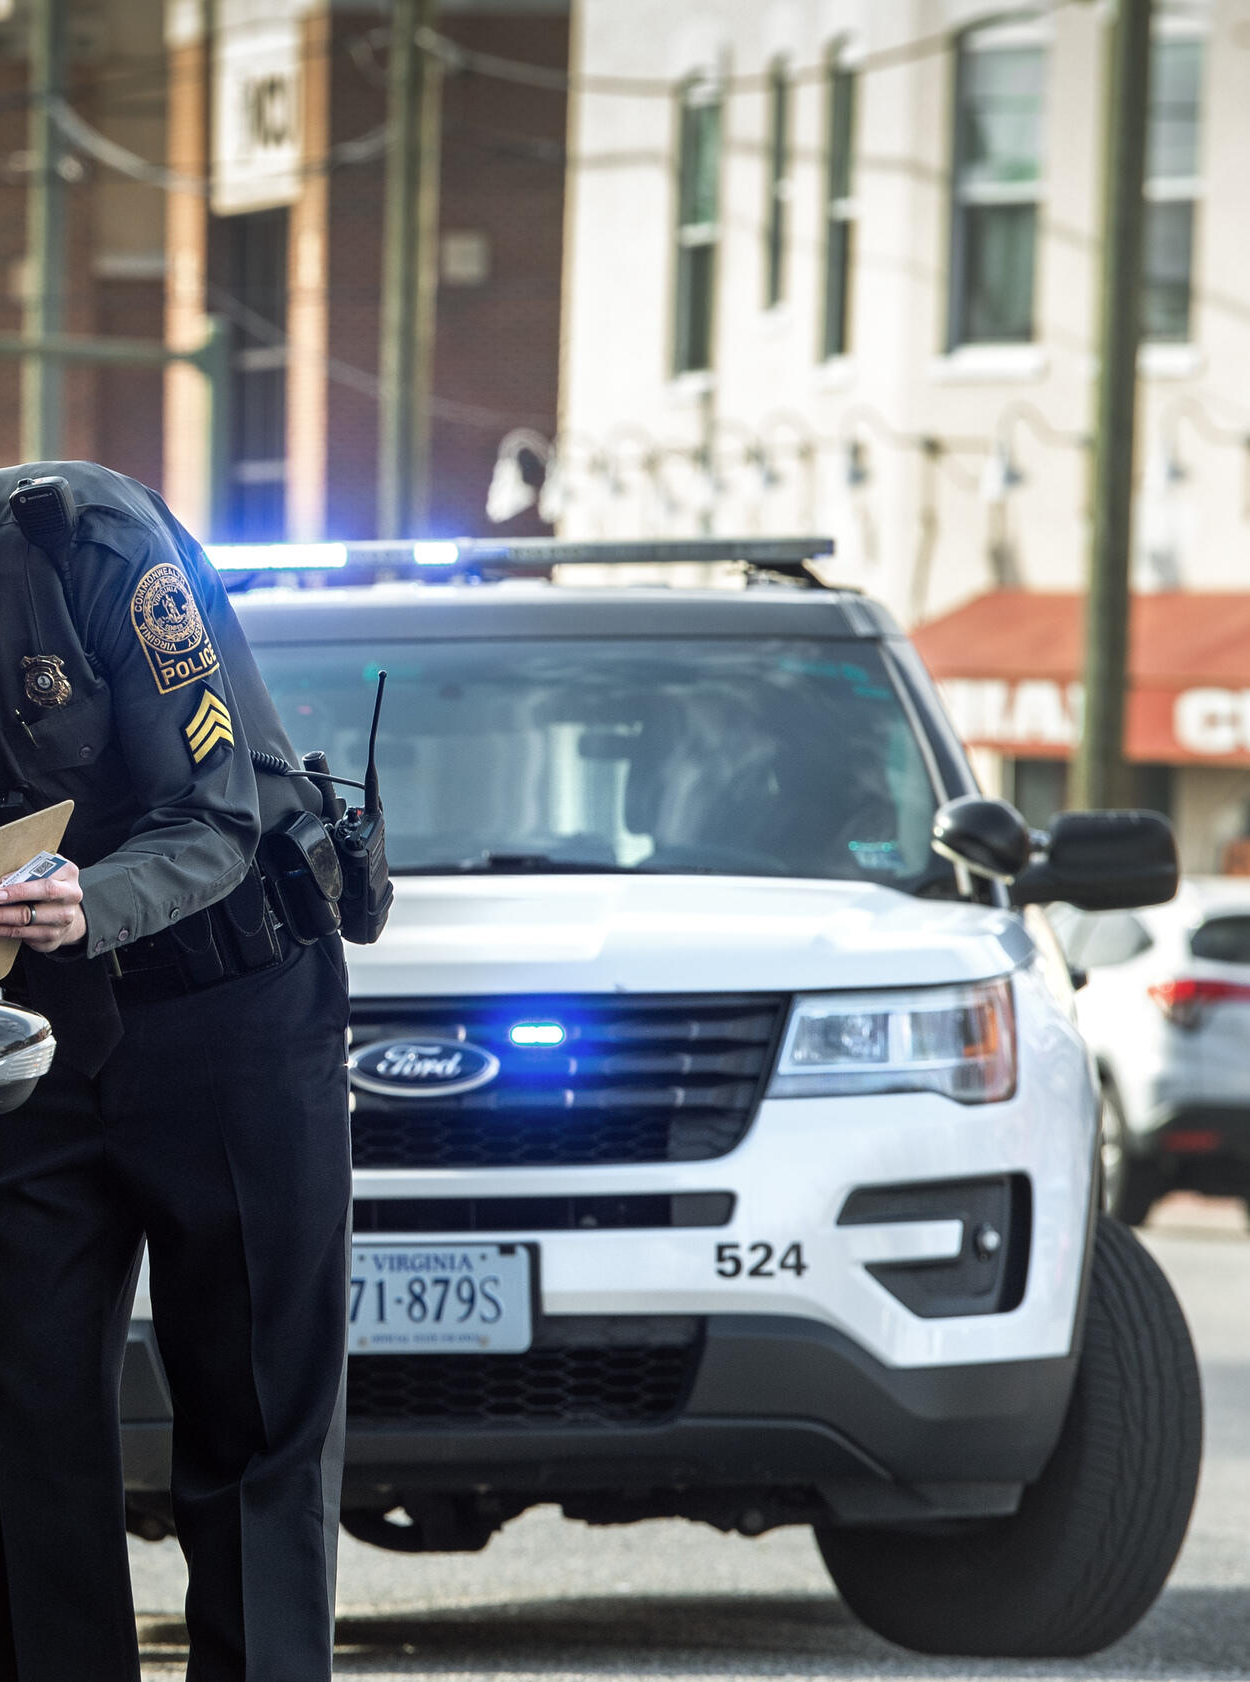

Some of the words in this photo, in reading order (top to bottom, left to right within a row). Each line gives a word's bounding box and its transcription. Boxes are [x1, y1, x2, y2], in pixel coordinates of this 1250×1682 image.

[134, 567, 186, 613] COMMONWEALTH
[139, 622, 177, 651] VIRGINIA
[376, 1045, 462, 1077] Ford
[372, 1253, 473, 1271] VIRGINIA
[716, 1242, 808, 1278] 524
